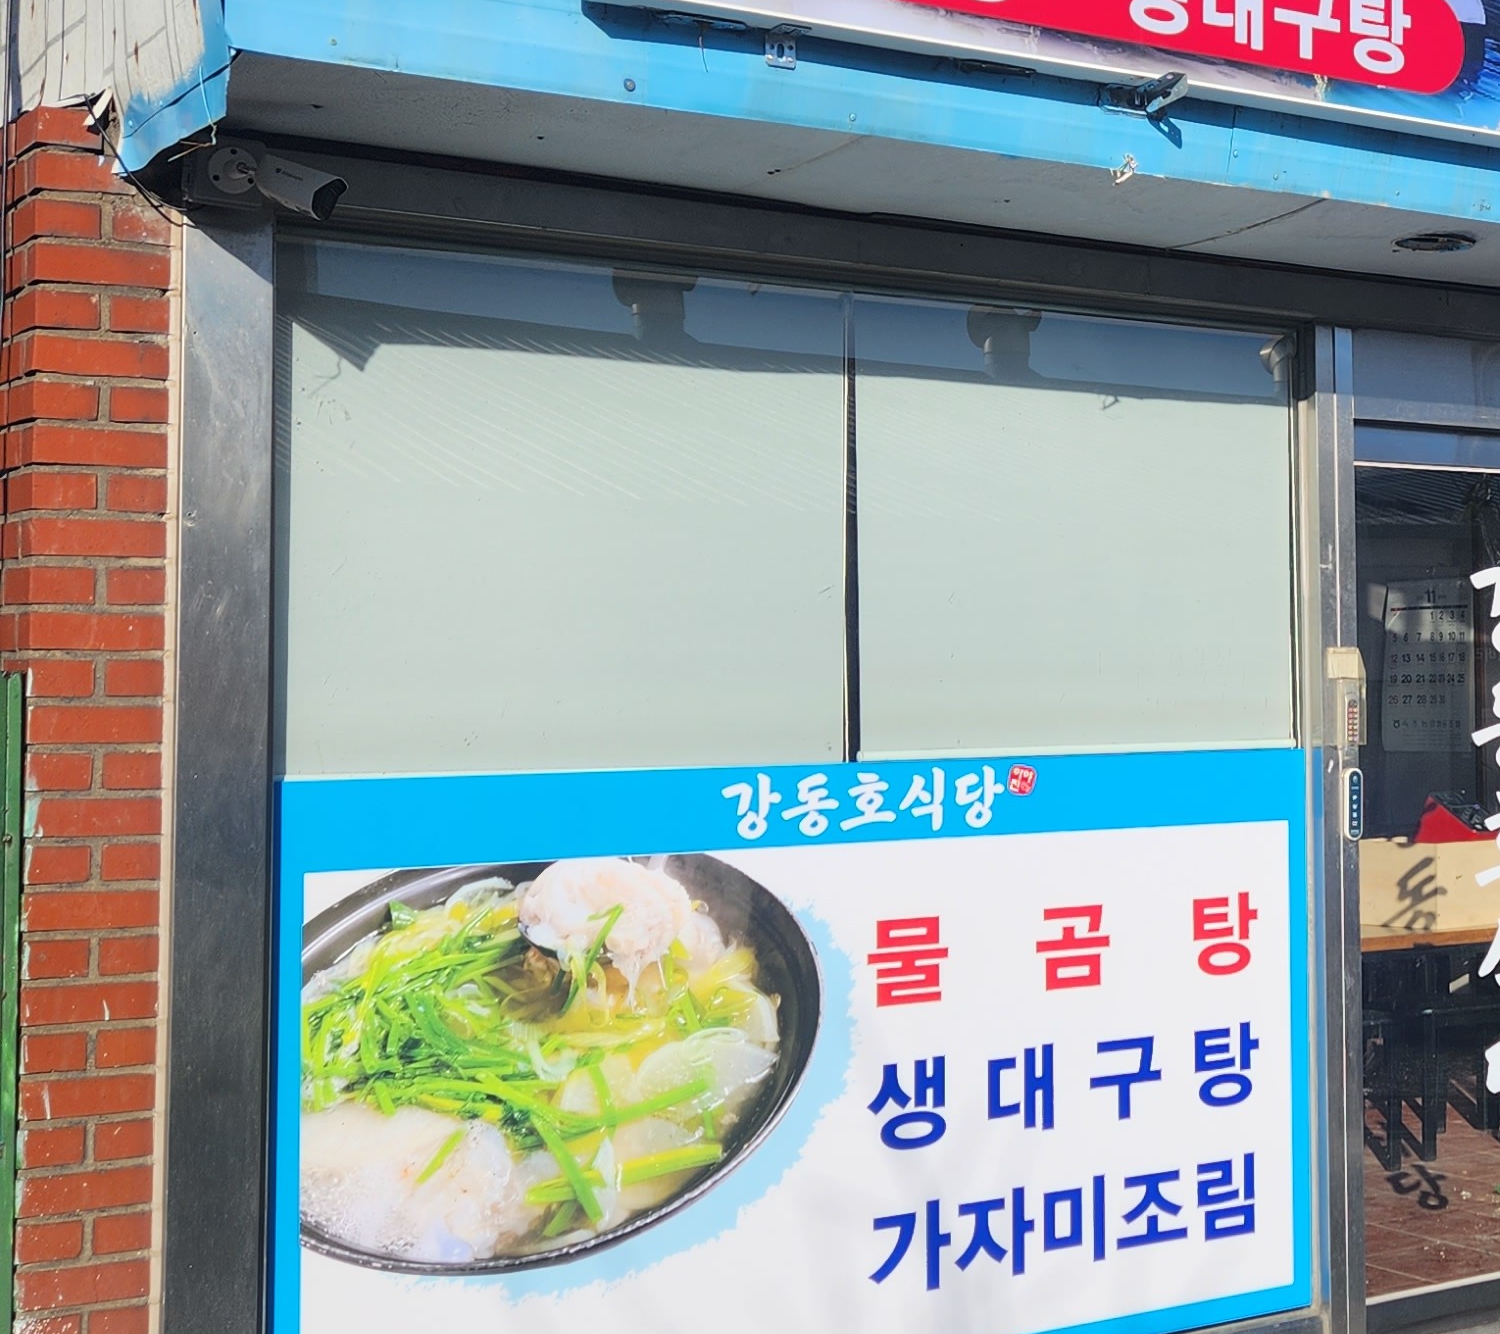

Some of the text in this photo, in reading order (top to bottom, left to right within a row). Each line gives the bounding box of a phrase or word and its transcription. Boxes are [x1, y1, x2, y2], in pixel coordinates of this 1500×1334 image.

[1424, 589, 1436, 603] 11
[1403, 632, 1408, 642] 6
[1416, 632, 1421, 641] 7
[1438, 632, 1443, 641] 9
[1448, 632, 1456, 641] 10
[1402, 653, 1411, 663] 13
[1416, 653, 1425, 662] 14
[1401, 674, 1412, 683] 20
[1415, 674, 1425, 683] 21
[1388, 695, 1398, 704] 26
[1402, 695, 1413, 704] 27
[1417, 695, 1427, 704] 28
[720, 764, 1005, 840] 강동호식당
[869, 1152, 1258, 1291] 가자미조림
